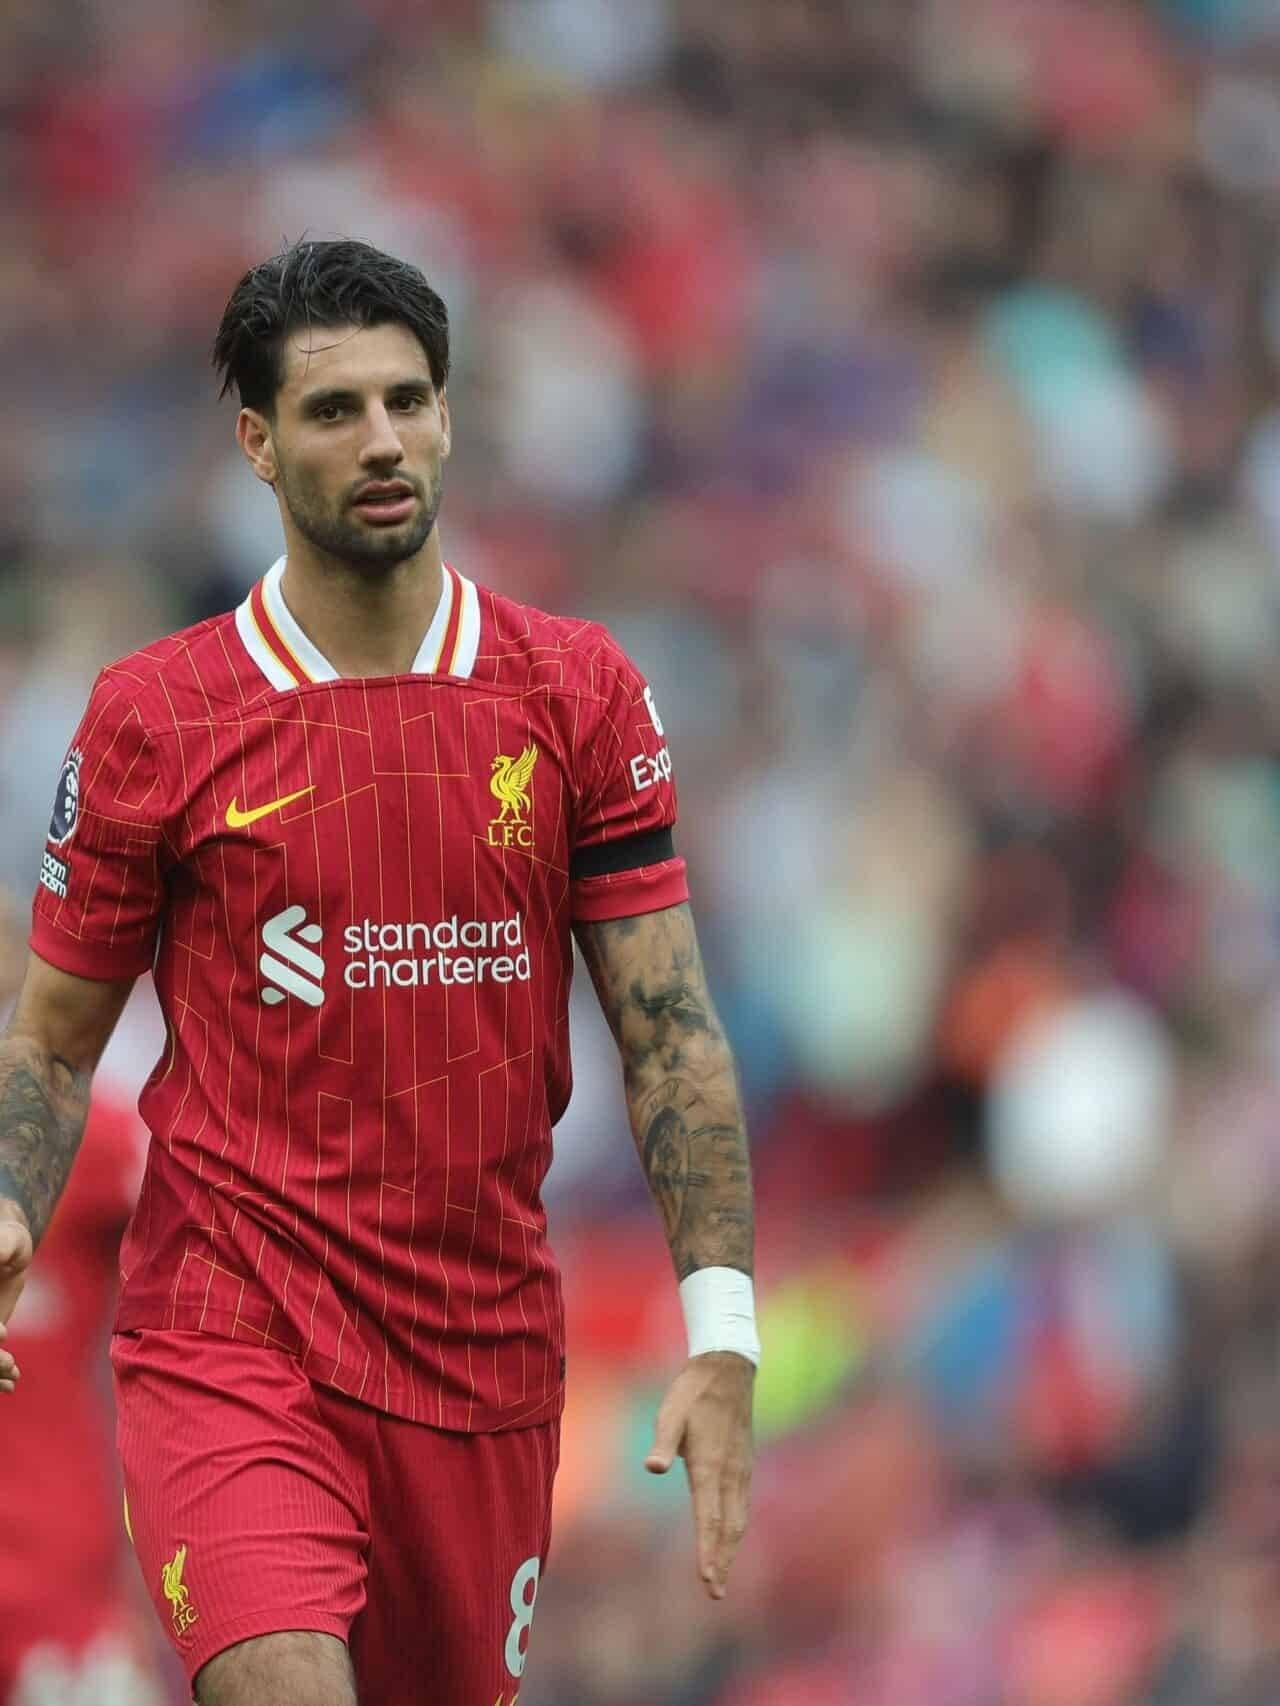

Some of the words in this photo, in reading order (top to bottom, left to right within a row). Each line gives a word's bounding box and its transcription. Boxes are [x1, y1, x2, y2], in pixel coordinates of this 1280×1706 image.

[344, 912, 522, 953] standard
[344, 945, 531, 989] chartered
[503, 1555, 540, 1678] 8
